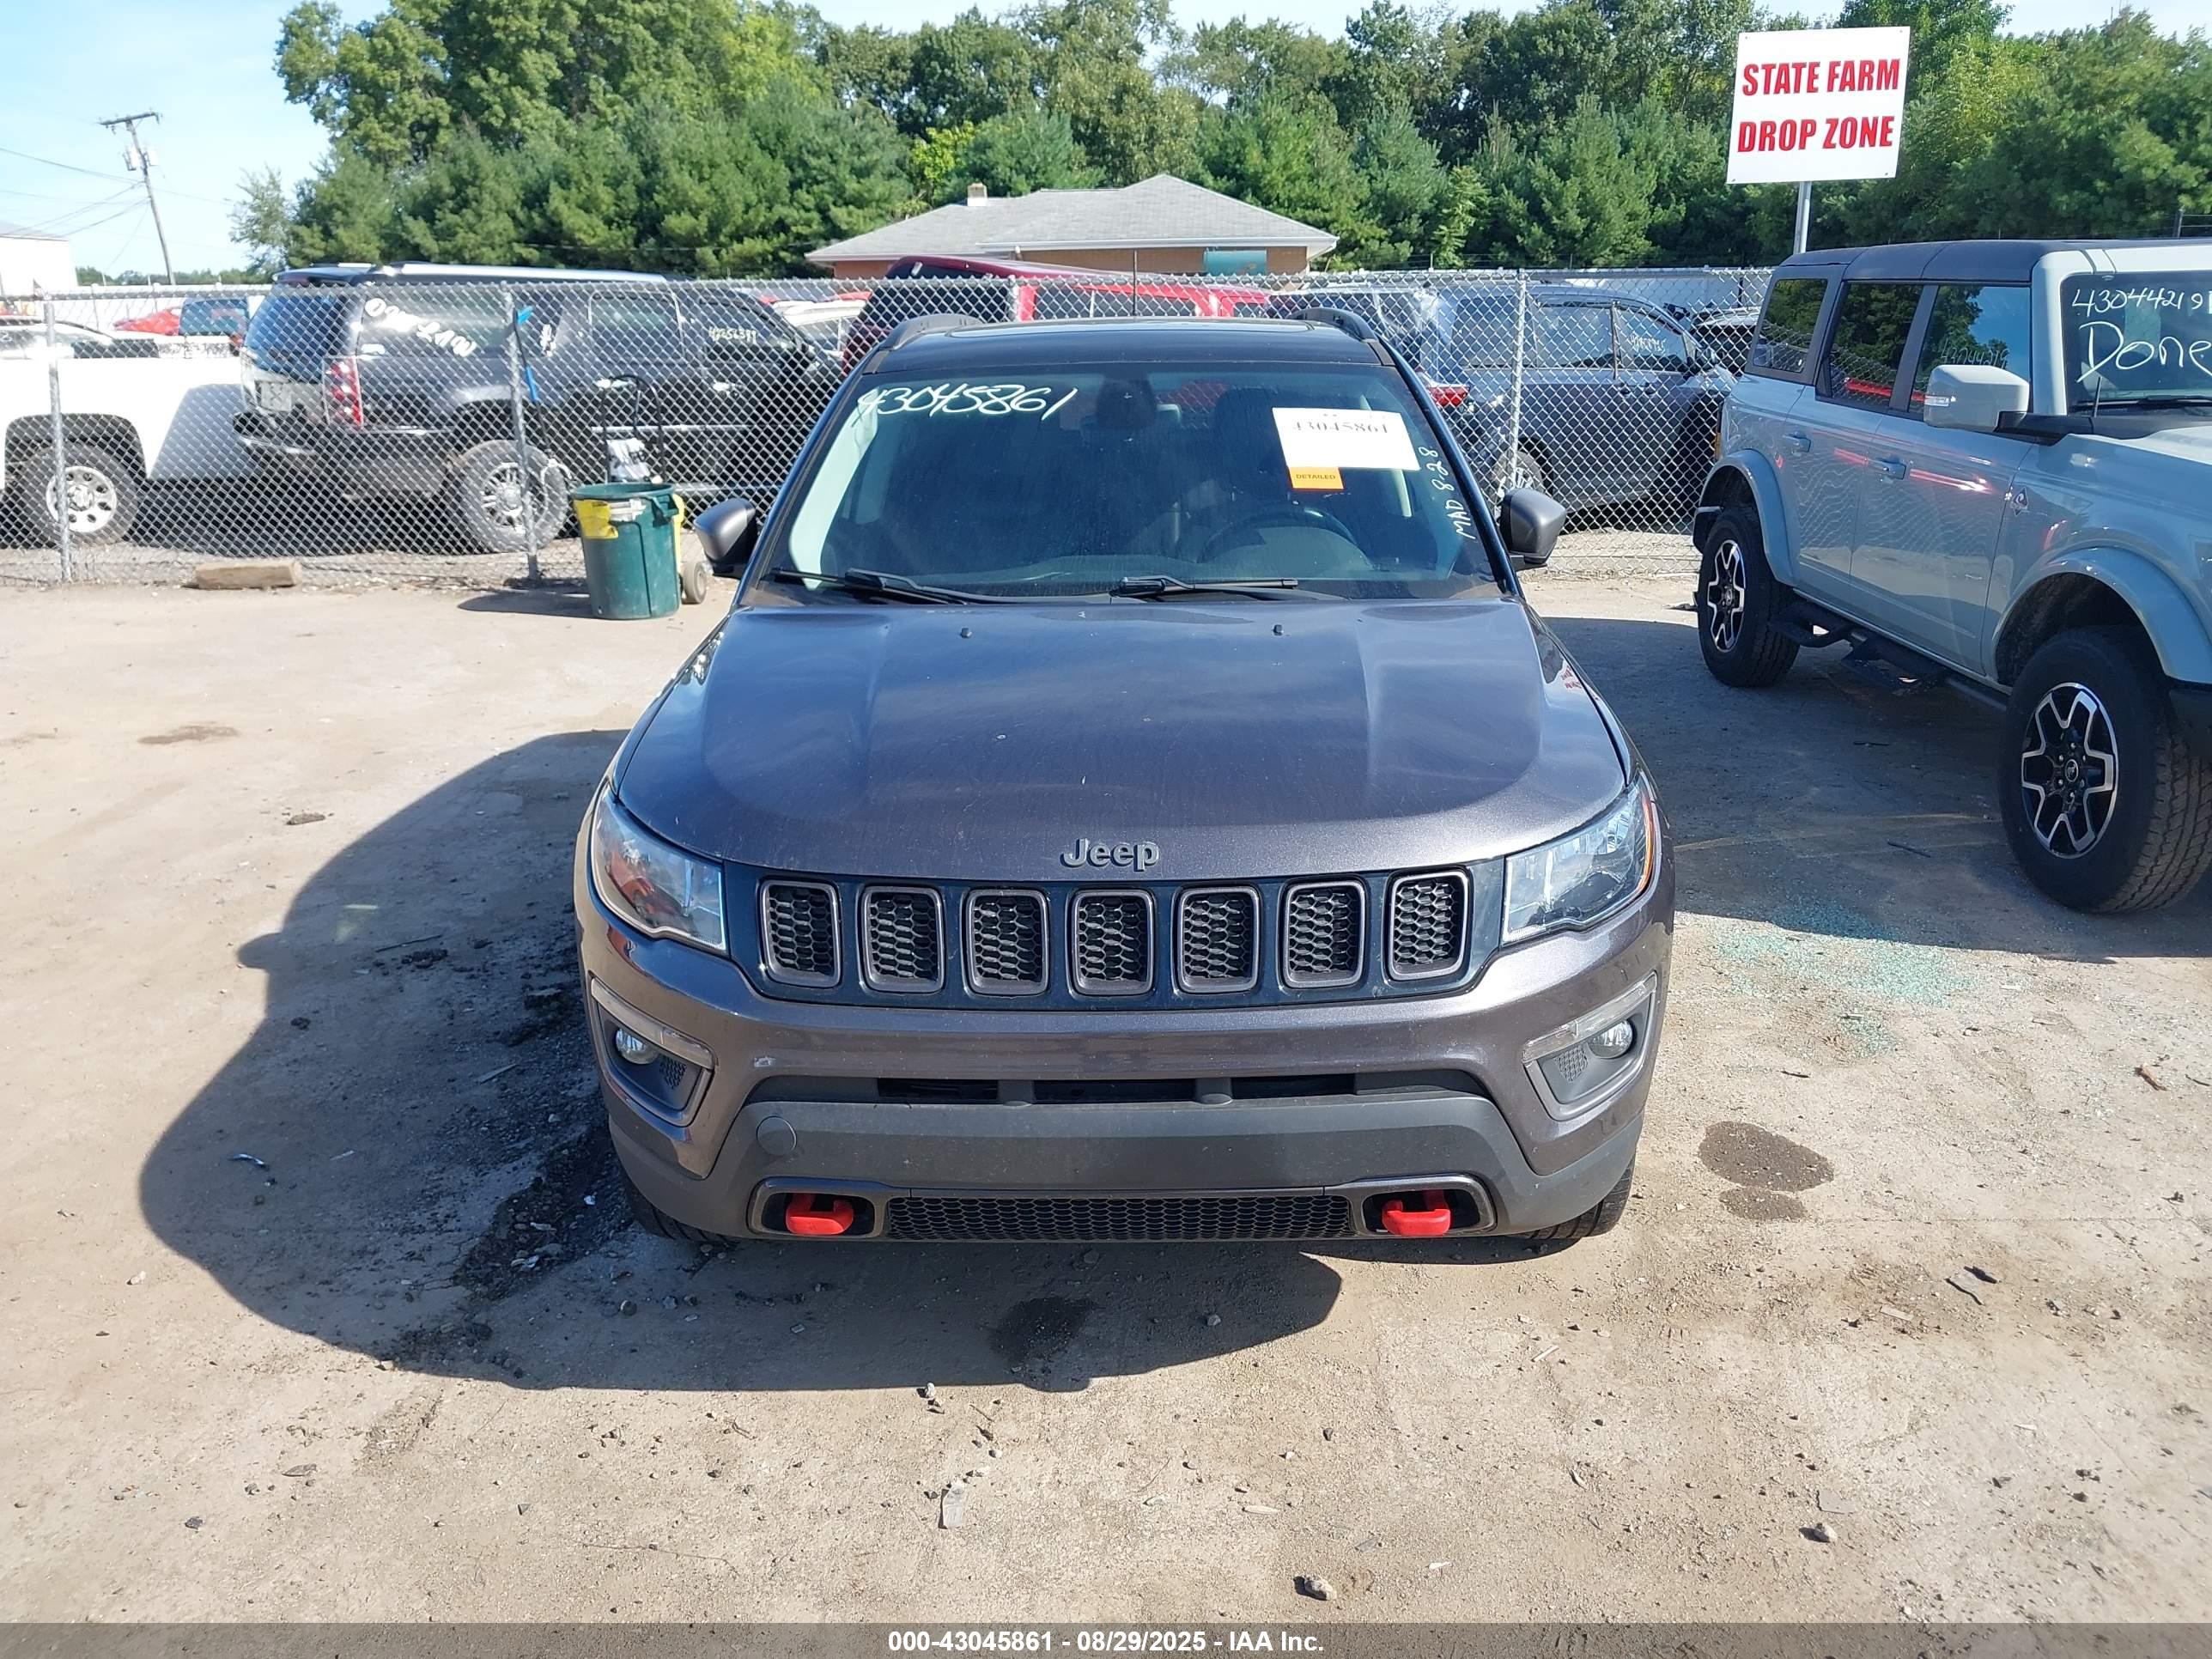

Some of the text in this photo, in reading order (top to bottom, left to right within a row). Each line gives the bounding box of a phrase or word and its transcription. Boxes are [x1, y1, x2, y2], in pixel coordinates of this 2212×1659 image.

[1742, 58, 1900, 96] STATE FARM
[1737, 116, 1895, 152] DROP ZONE
[2072, 288, 2203, 318] 43044219
[2076, 321, 2212, 383] Done
[853, 383, 1078, 422] 43045861
[1060, 838, 1160, 872] Jeep
